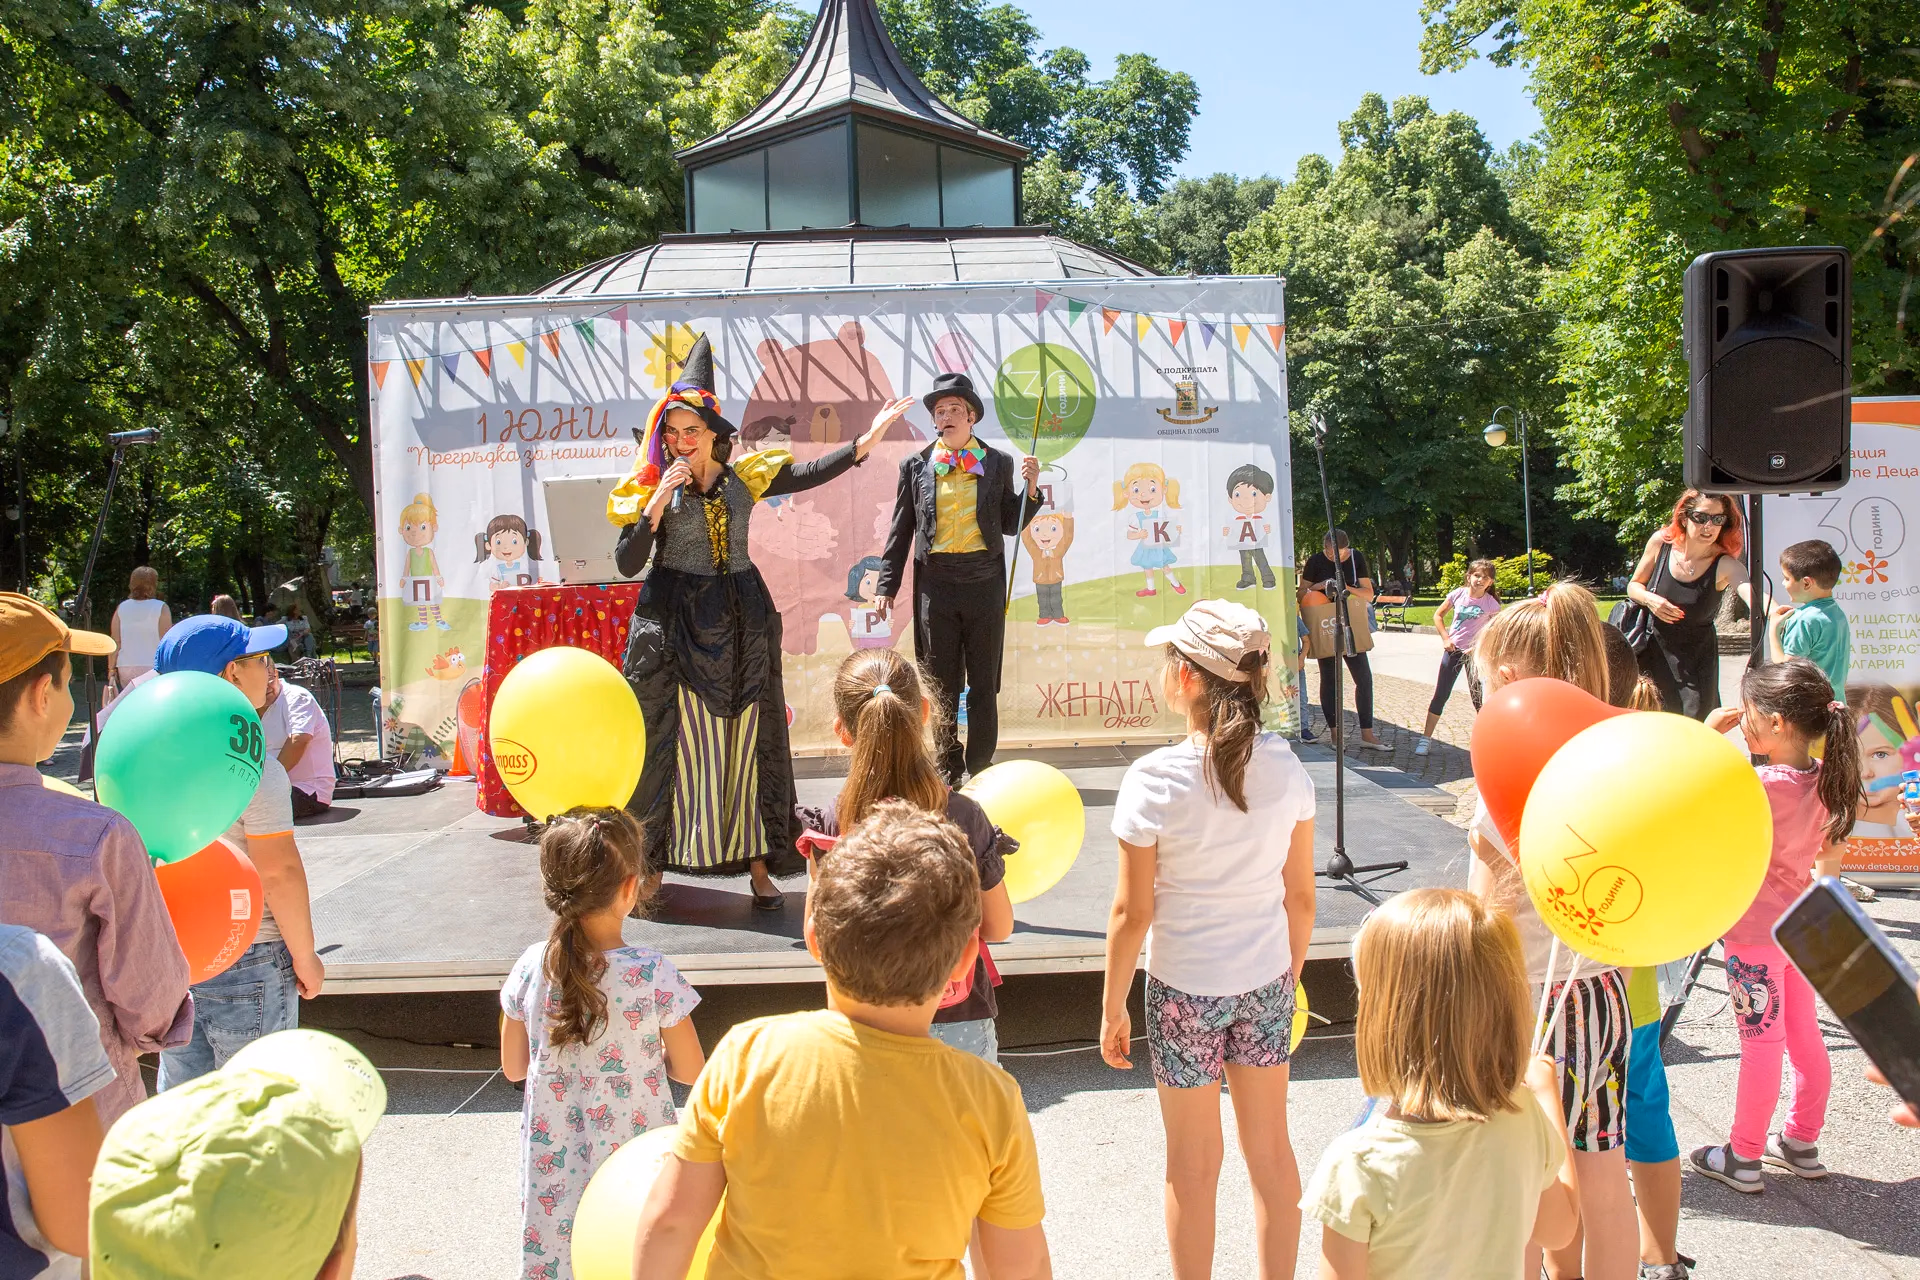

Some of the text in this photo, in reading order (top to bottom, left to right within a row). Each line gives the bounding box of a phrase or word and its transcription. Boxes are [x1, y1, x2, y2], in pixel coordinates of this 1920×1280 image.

[1164, 366, 1218, 375] ПОДКРЕПАТА
[1058, 374, 1068, 415] ГОДИНИ
[476, 405, 619, 444] 1 ЮНИ
[1157, 427, 1220, 436] ОБЩИНА ПЛОВДИВ
[519, 447, 548, 468] за
[550, 444, 632, 461] нашите
[1876, 465, 1919, 479] Деца
[1870, 505, 1883, 550] ГОДИНИ
[412, 579, 431, 602] П
[1849, 614, 1860, 624] И
[1855, 629, 1875, 639] НА
[1035, 680, 1159, 718] ЖЕНАТА
[1103, 714, 1156, 729] днес
[1840, 862, 1919, 873] www.detebg.org
[1598, 876, 1626, 915] ГОДИНИ
